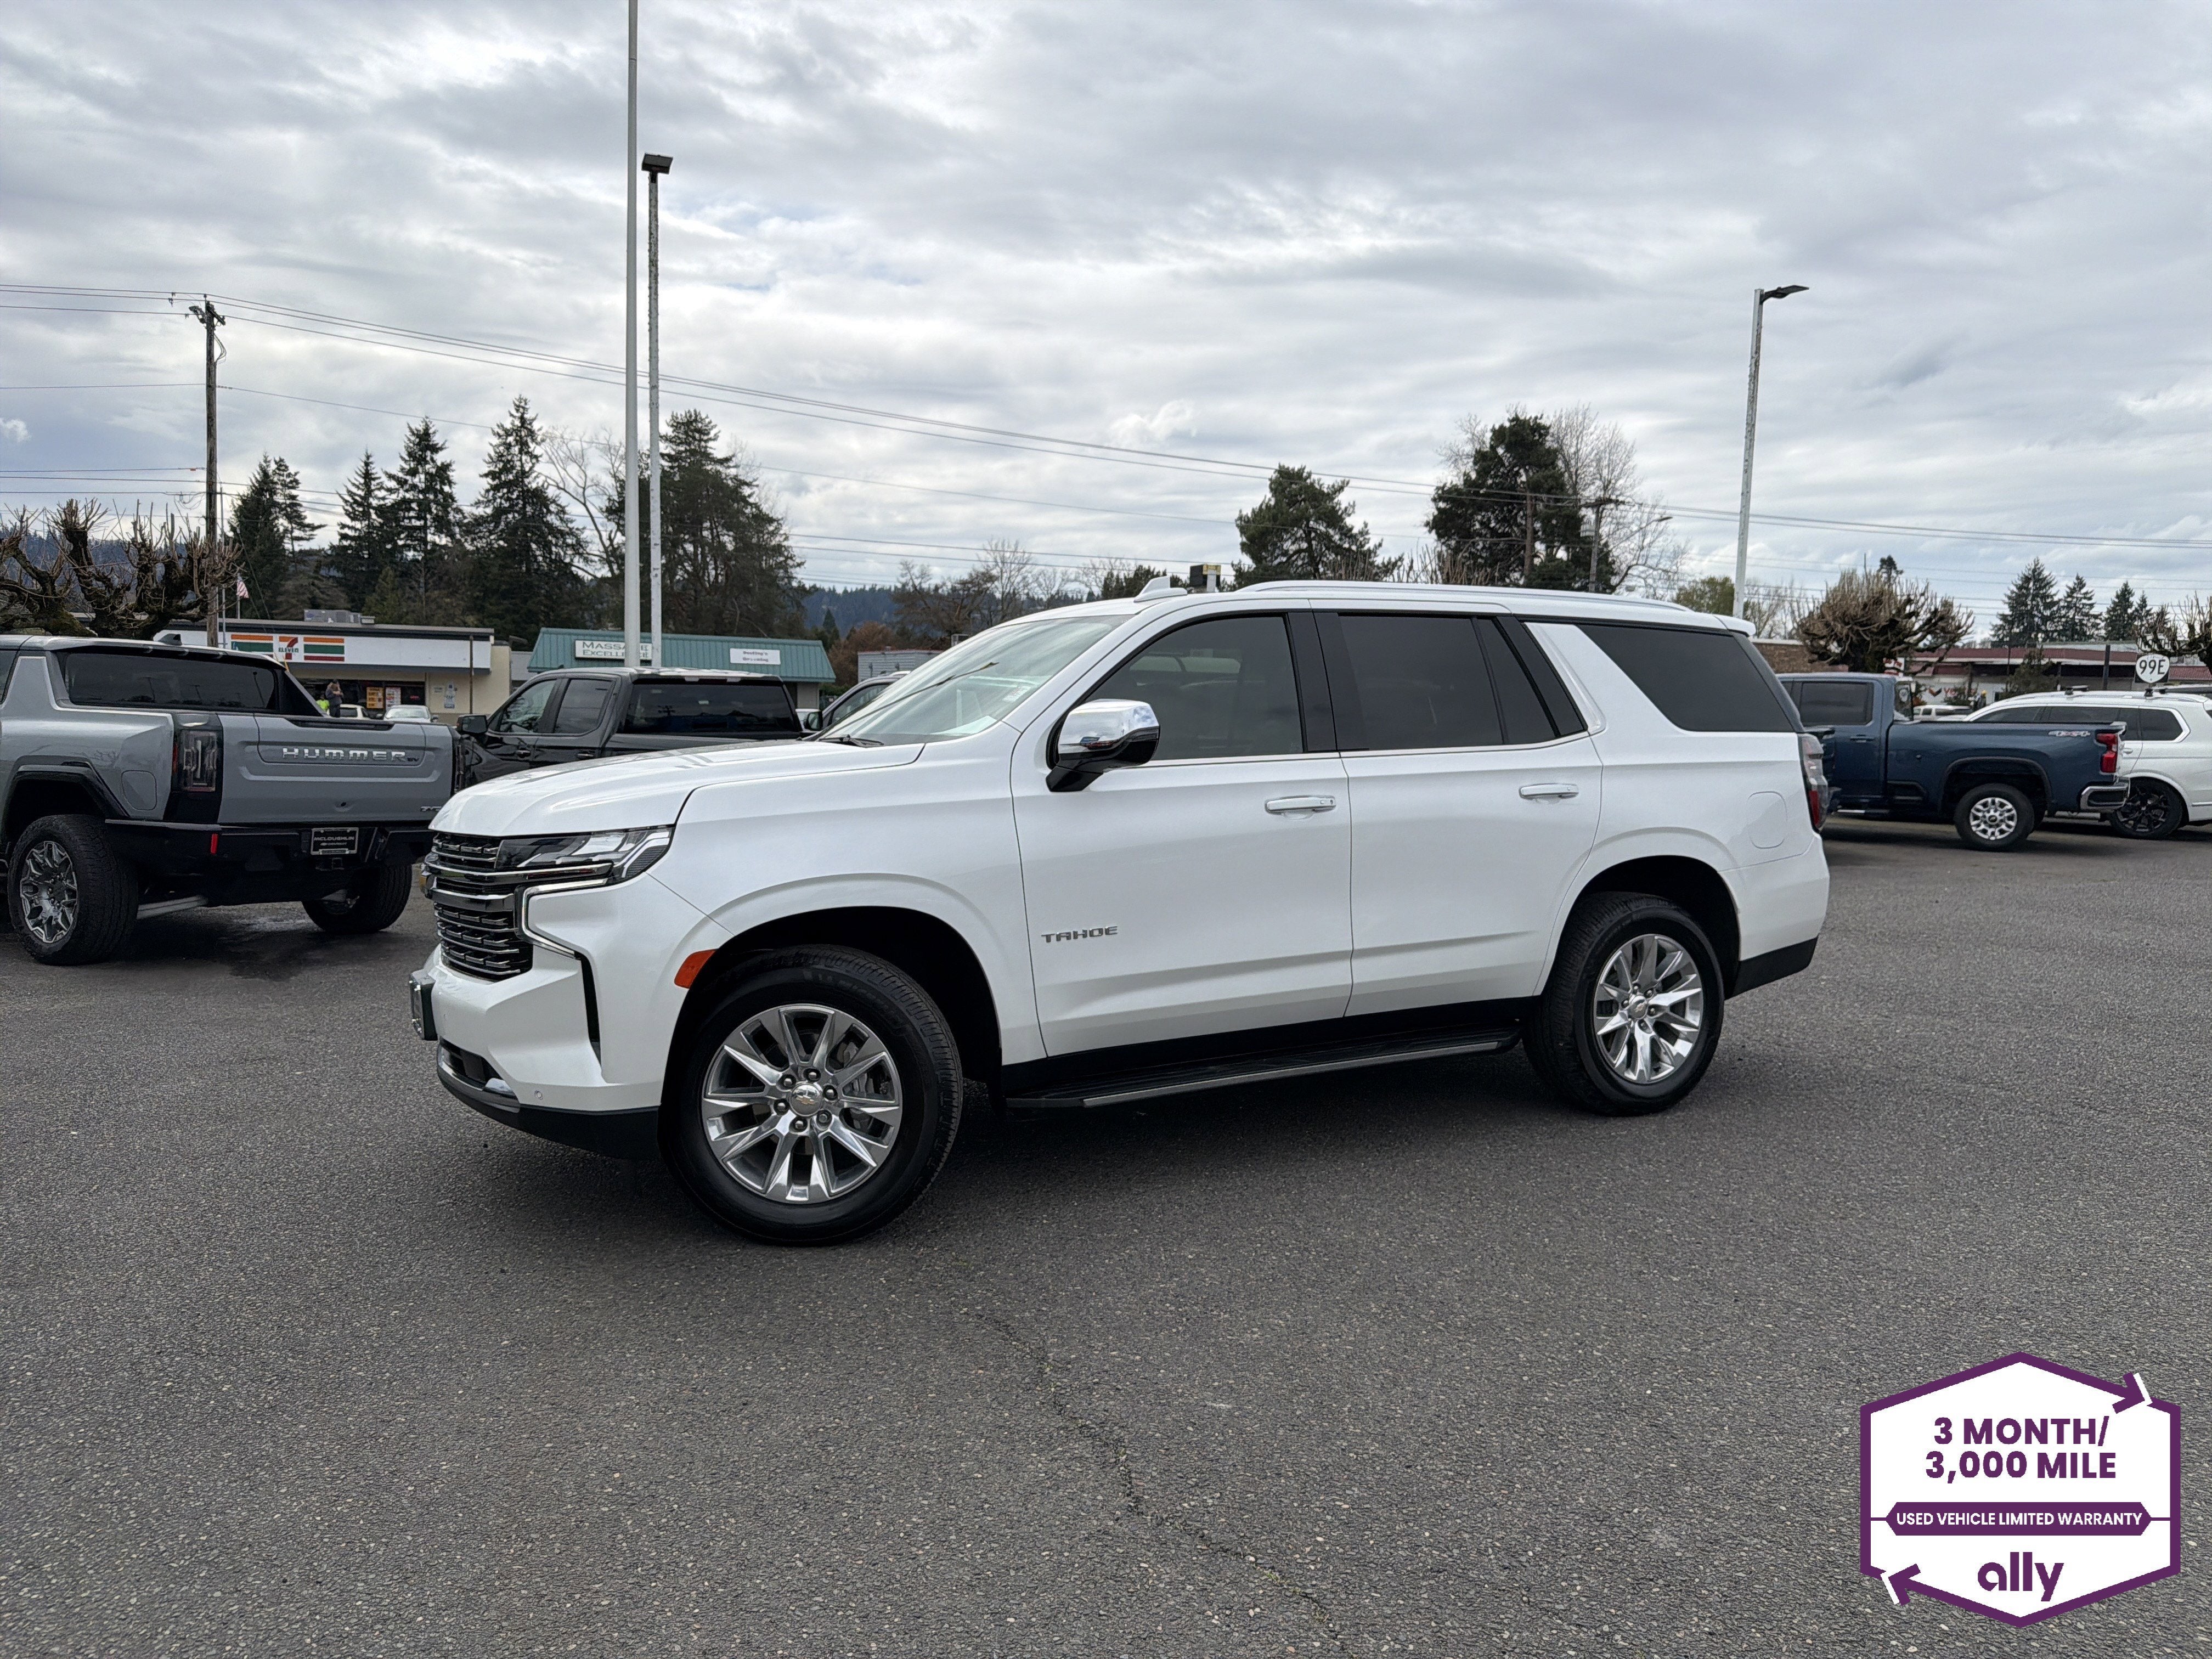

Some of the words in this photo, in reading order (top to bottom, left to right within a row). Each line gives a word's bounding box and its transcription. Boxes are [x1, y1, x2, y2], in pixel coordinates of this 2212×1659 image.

[279, 636, 298, 660] 7
[2139, 659, 2166, 675] 99E
[282, 748, 406, 761] HUMMER
[1041, 926, 1118, 943] TAHOE
